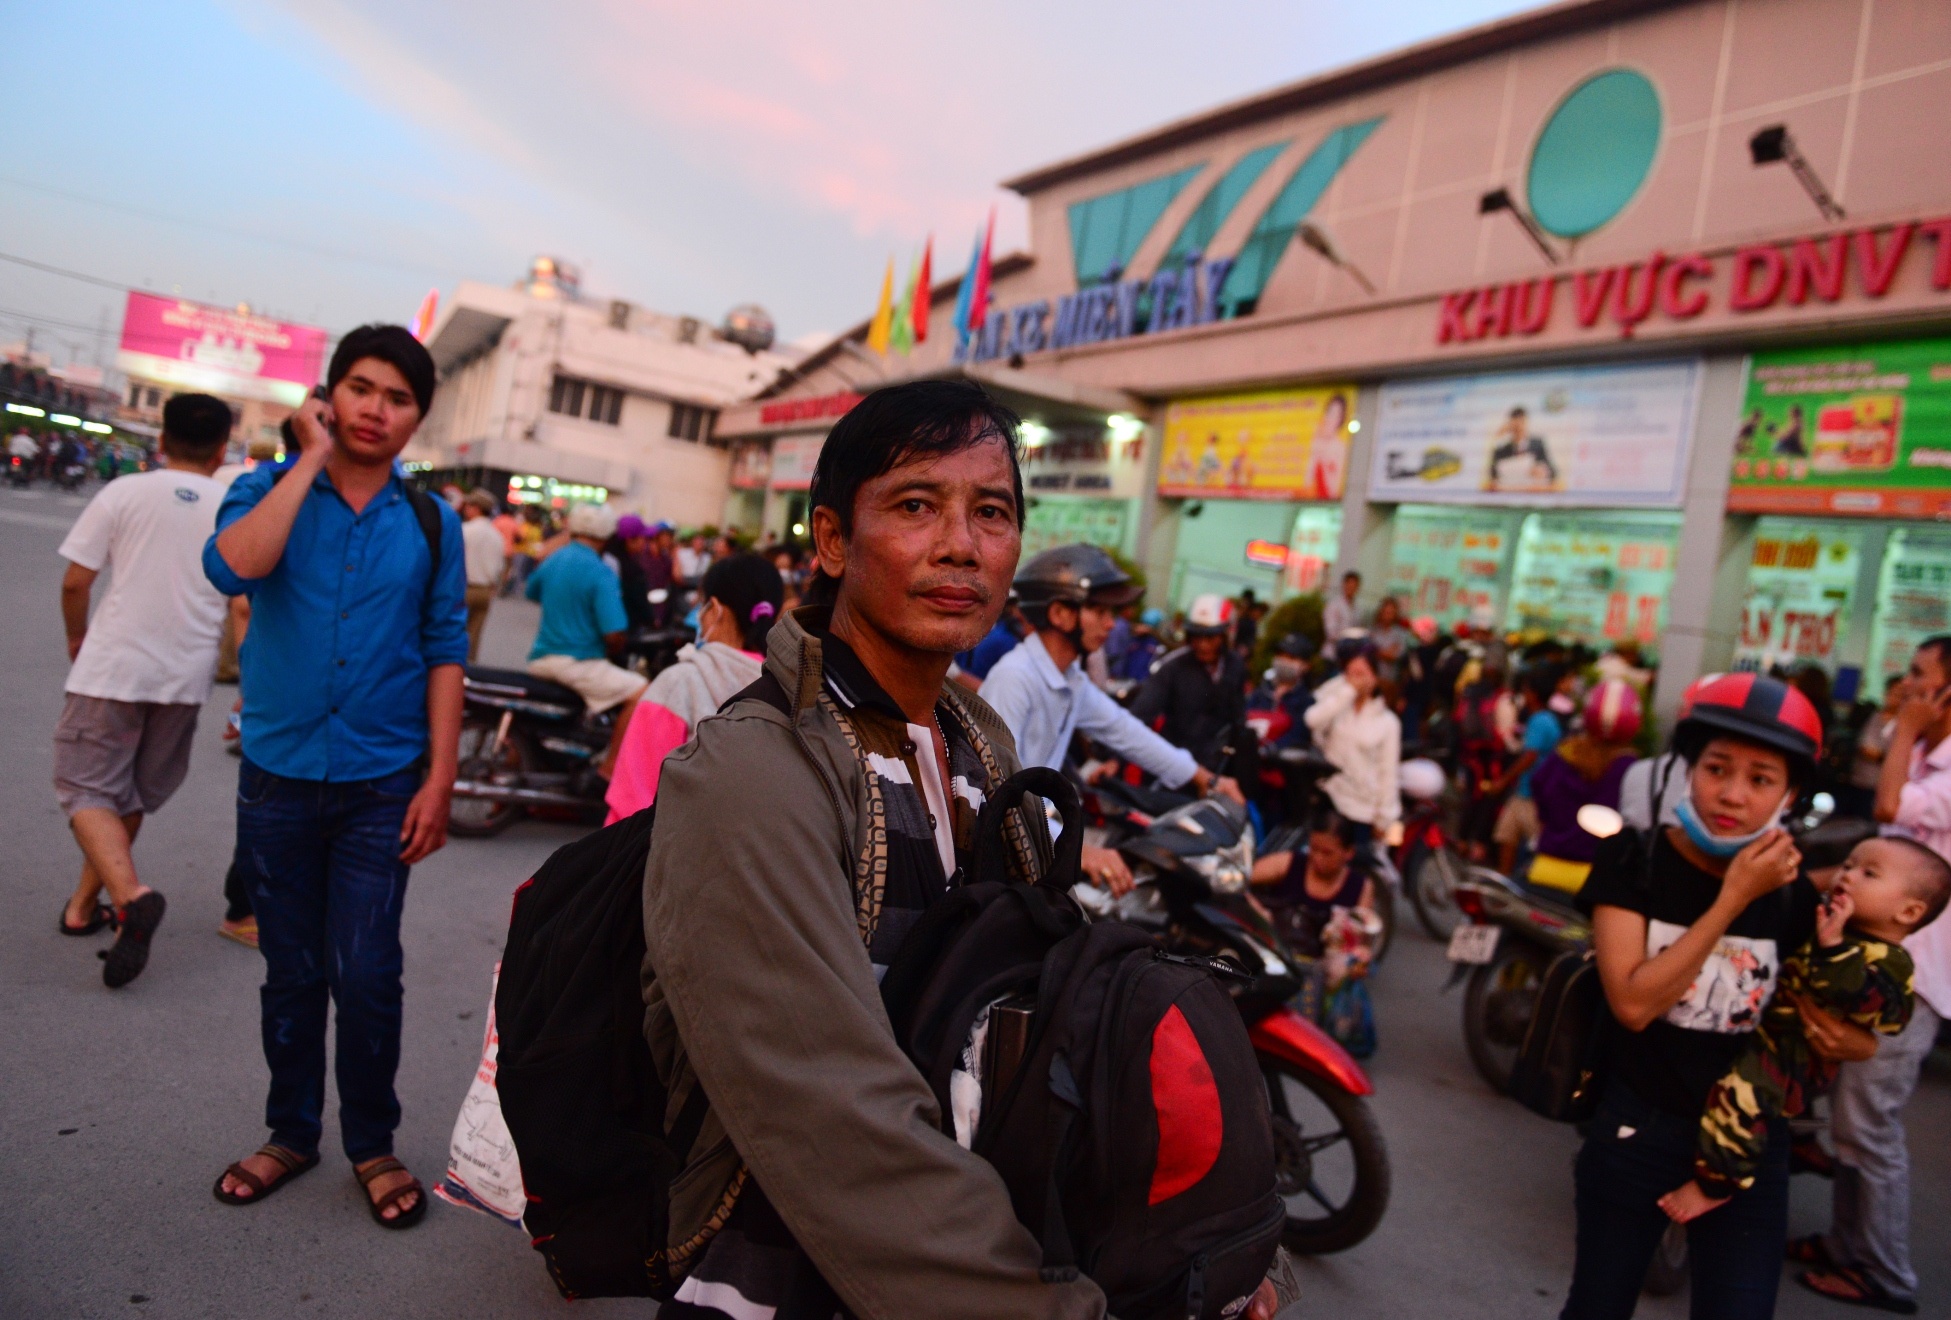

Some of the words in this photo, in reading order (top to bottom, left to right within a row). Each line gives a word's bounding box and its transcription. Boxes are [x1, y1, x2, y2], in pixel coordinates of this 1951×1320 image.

[1438, 278, 1556, 344] KHU
[1574, 251, 1711, 337] VỰC
[1209, 961, 1233, 973] YAMAHA
